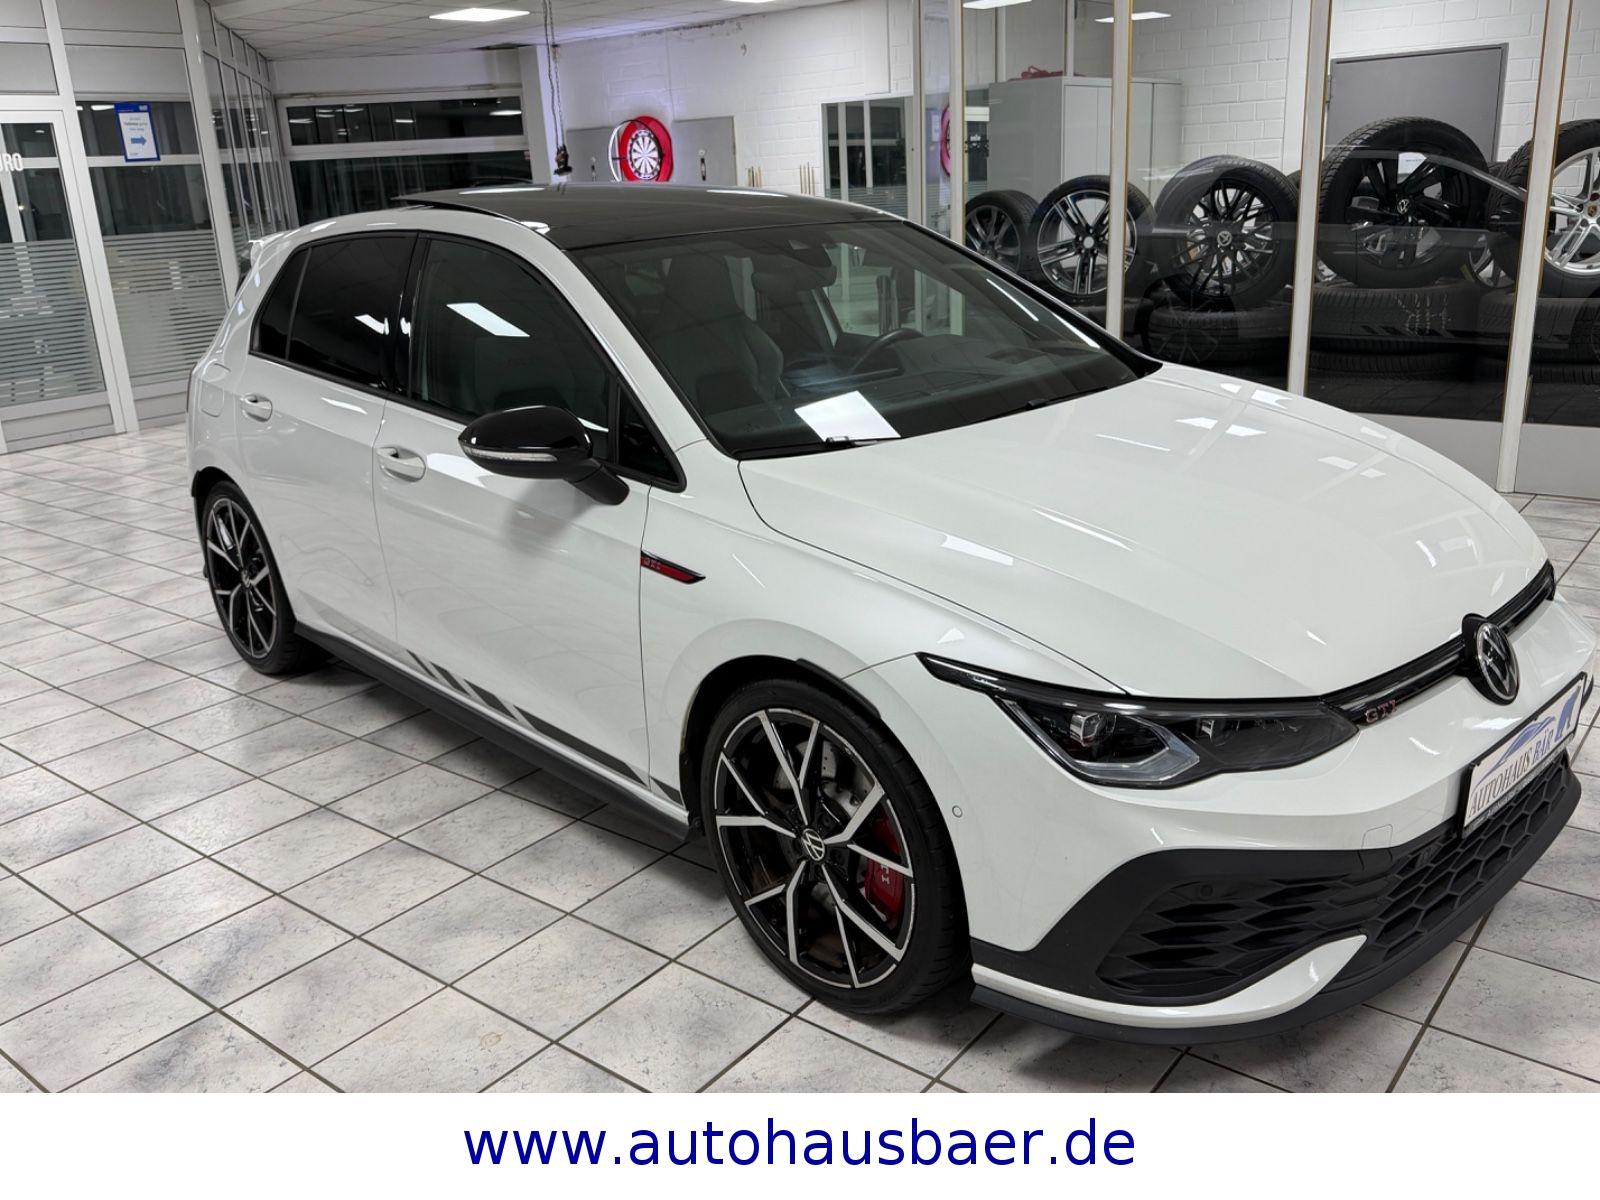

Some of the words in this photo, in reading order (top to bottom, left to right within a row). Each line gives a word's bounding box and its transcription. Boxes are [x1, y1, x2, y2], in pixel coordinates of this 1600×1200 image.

[0, 152, 24, 171] RO
[1365, 699, 1397, 723] GTI
[1468, 747, 1532, 818] AUTOHAUS
